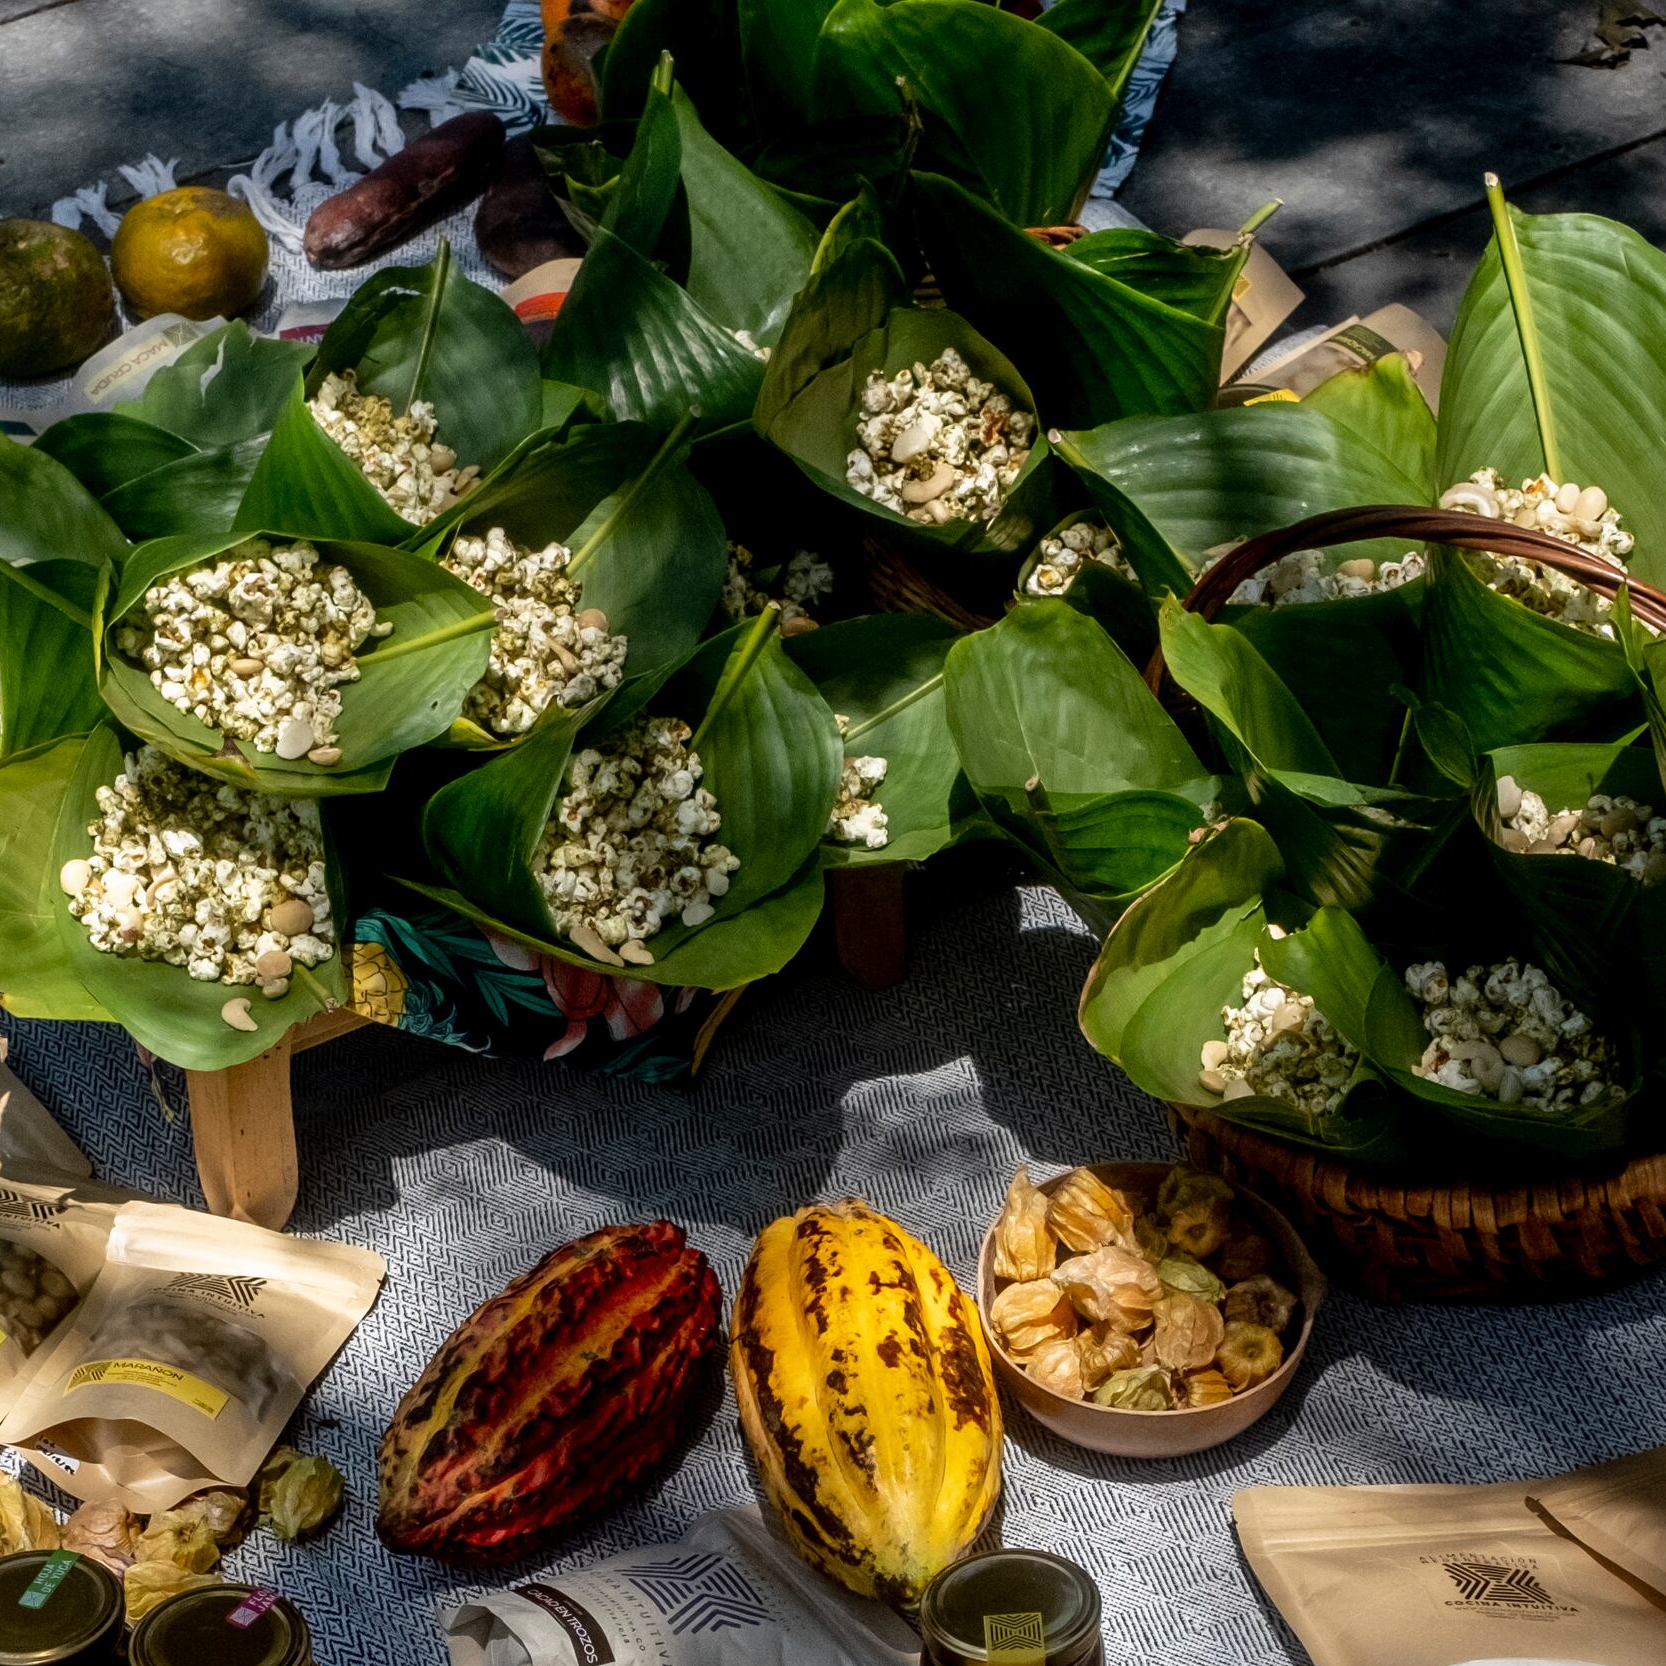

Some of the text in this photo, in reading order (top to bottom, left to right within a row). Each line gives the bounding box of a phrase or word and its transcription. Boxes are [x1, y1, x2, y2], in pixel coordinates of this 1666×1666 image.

[91, 338, 169, 395] MACA CRUDA
[33, 1564, 55, 1585] HOJA
[40, 1560, 73, 1593] DE YUCA
[1506, 1602, 1580, 1613] INTUITIVA
[526, 1588, 558, 1607] CACAO
[554, 1605, 572, 1618] EN
[566, 1615, 599, 1664] TROZOS
